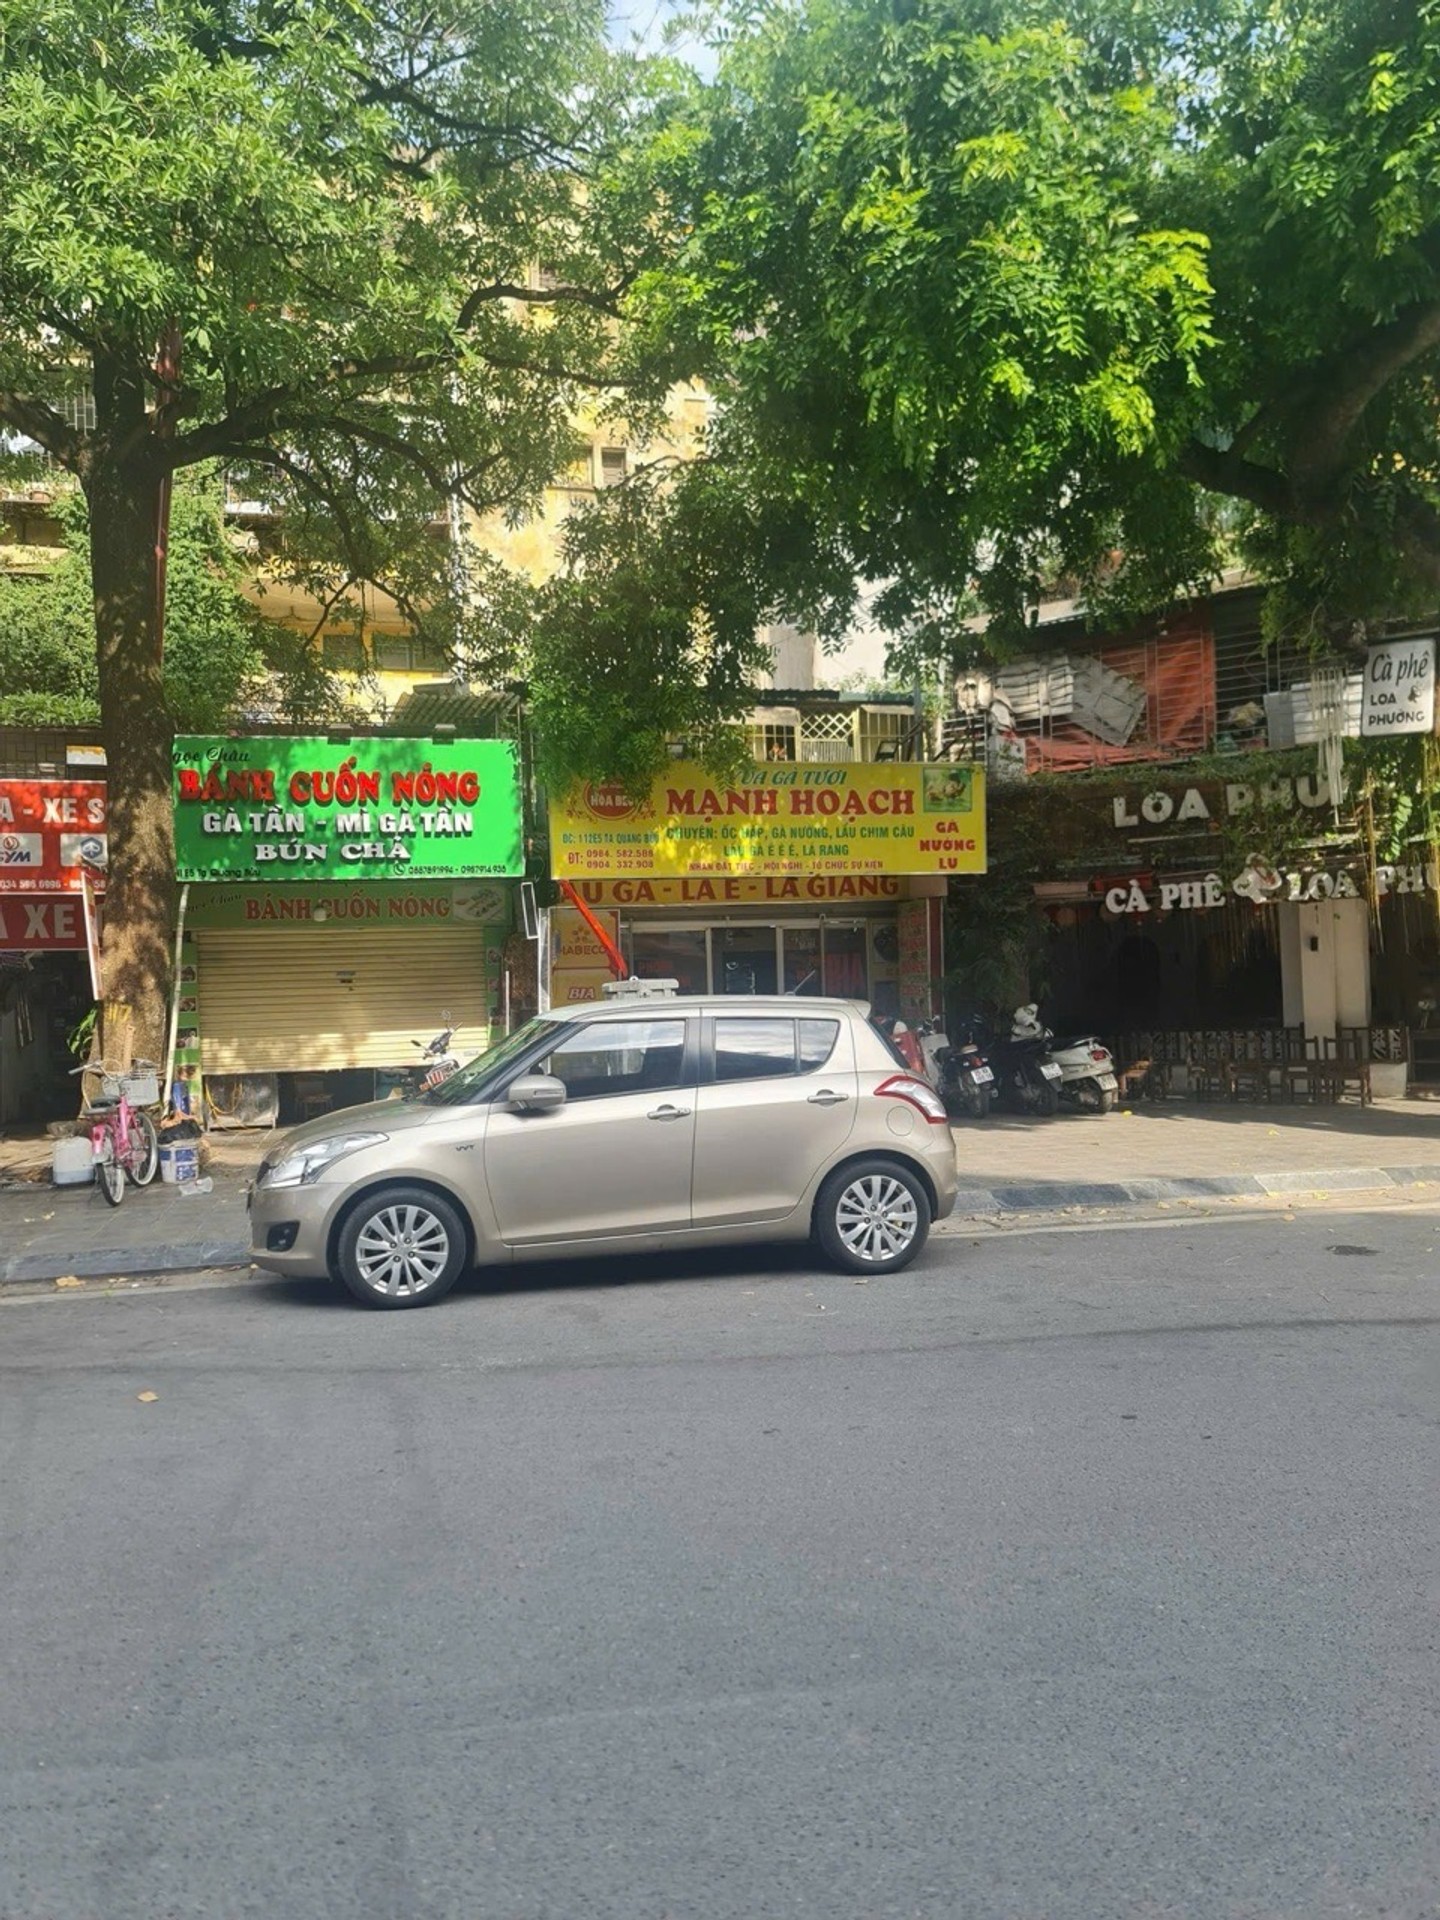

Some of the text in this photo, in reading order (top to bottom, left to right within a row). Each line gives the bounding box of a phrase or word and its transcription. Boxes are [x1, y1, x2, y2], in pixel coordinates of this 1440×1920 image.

[1372, 650, 1430, 687] Cà phê
[1370, 692, 1396, 705] LOA
[178, 756, 481, 806] BÁNH CUỐN NÓNG
[772, 766, 797, 785] GÀ
[802, 768, 848, 785] TƯƠI
[43, 798, 78, 823] XE
[203, 807, 243, 833] GÀ
[249, 804, 305, 833] TẦN
[337, 807, 371, 833] MÌ
[379, 806, 416, 833] GÀ
[421, 803, 474, 833] TẦN
[666, 789, 915, 823] MẠNH HOẠCH
[1112, 788, 1210, 828] LOA
[666, 824, 718, 839] CHUYÊN:
[772, 824, 788, 838] GÀ
[860, 827, 889, 838] CHIM
[936, 819, 959, 833] GÀ
[255, 835, 411, 861] BÚN CHẢ
[568, 852, 583, 865] ĐT:
[1106, 881, 1151, 913] CÀ
[1160, 873, 1226, 911] PHÊ
[1286, 870, 1360, 901] LOA
[246, 893, 311, 920] BÁNH
[388, 891, 450, 918] NÓNG
[24, 904, 77, 939] XE
[568, 987, 595, 1000] BIA
